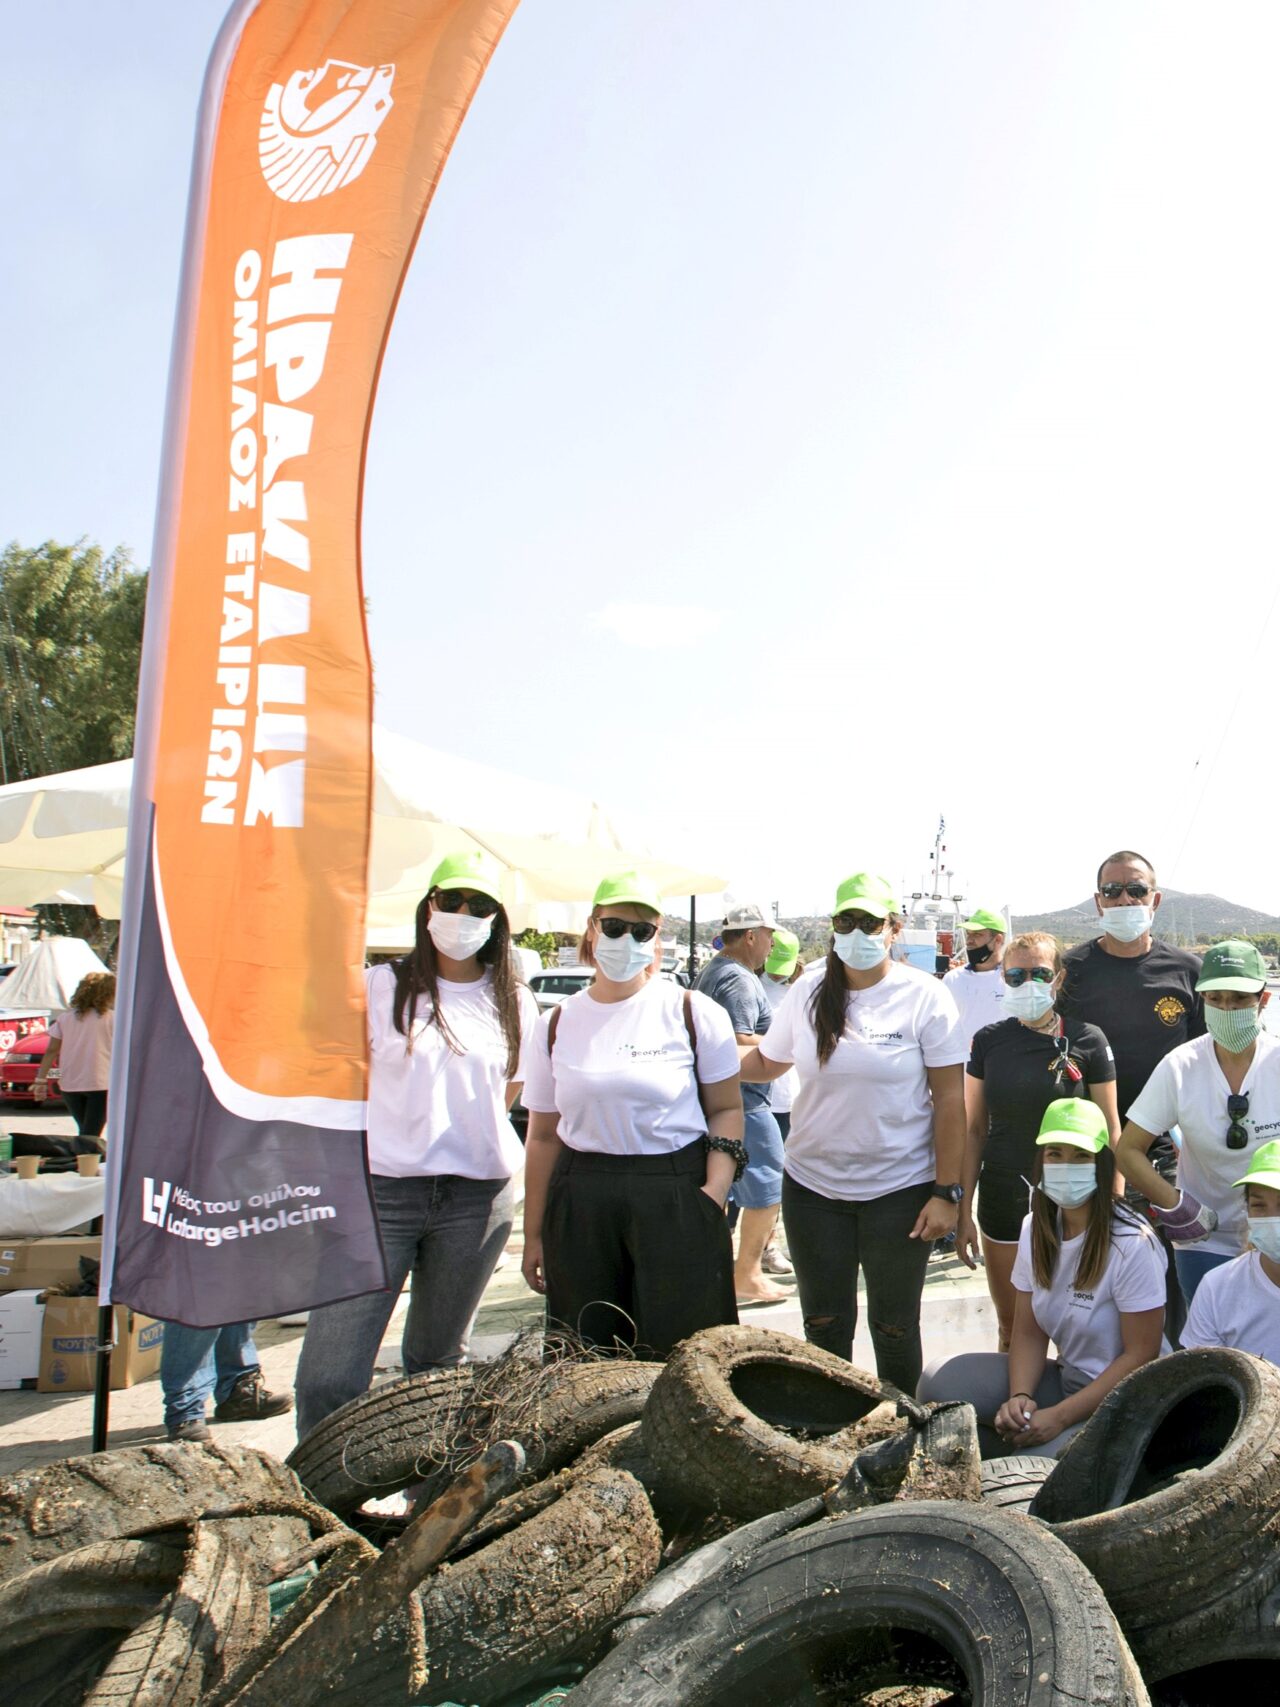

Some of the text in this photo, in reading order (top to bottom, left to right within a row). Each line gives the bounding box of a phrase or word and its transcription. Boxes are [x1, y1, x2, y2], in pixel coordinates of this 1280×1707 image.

[201, 249, 262, 825] ΟΜΙΛΟΣ ΕΤΑΙΡΙΩΝ
[203, 1200, 241, 1214] του
[247, 1183, 322, 1209] ομίλου
